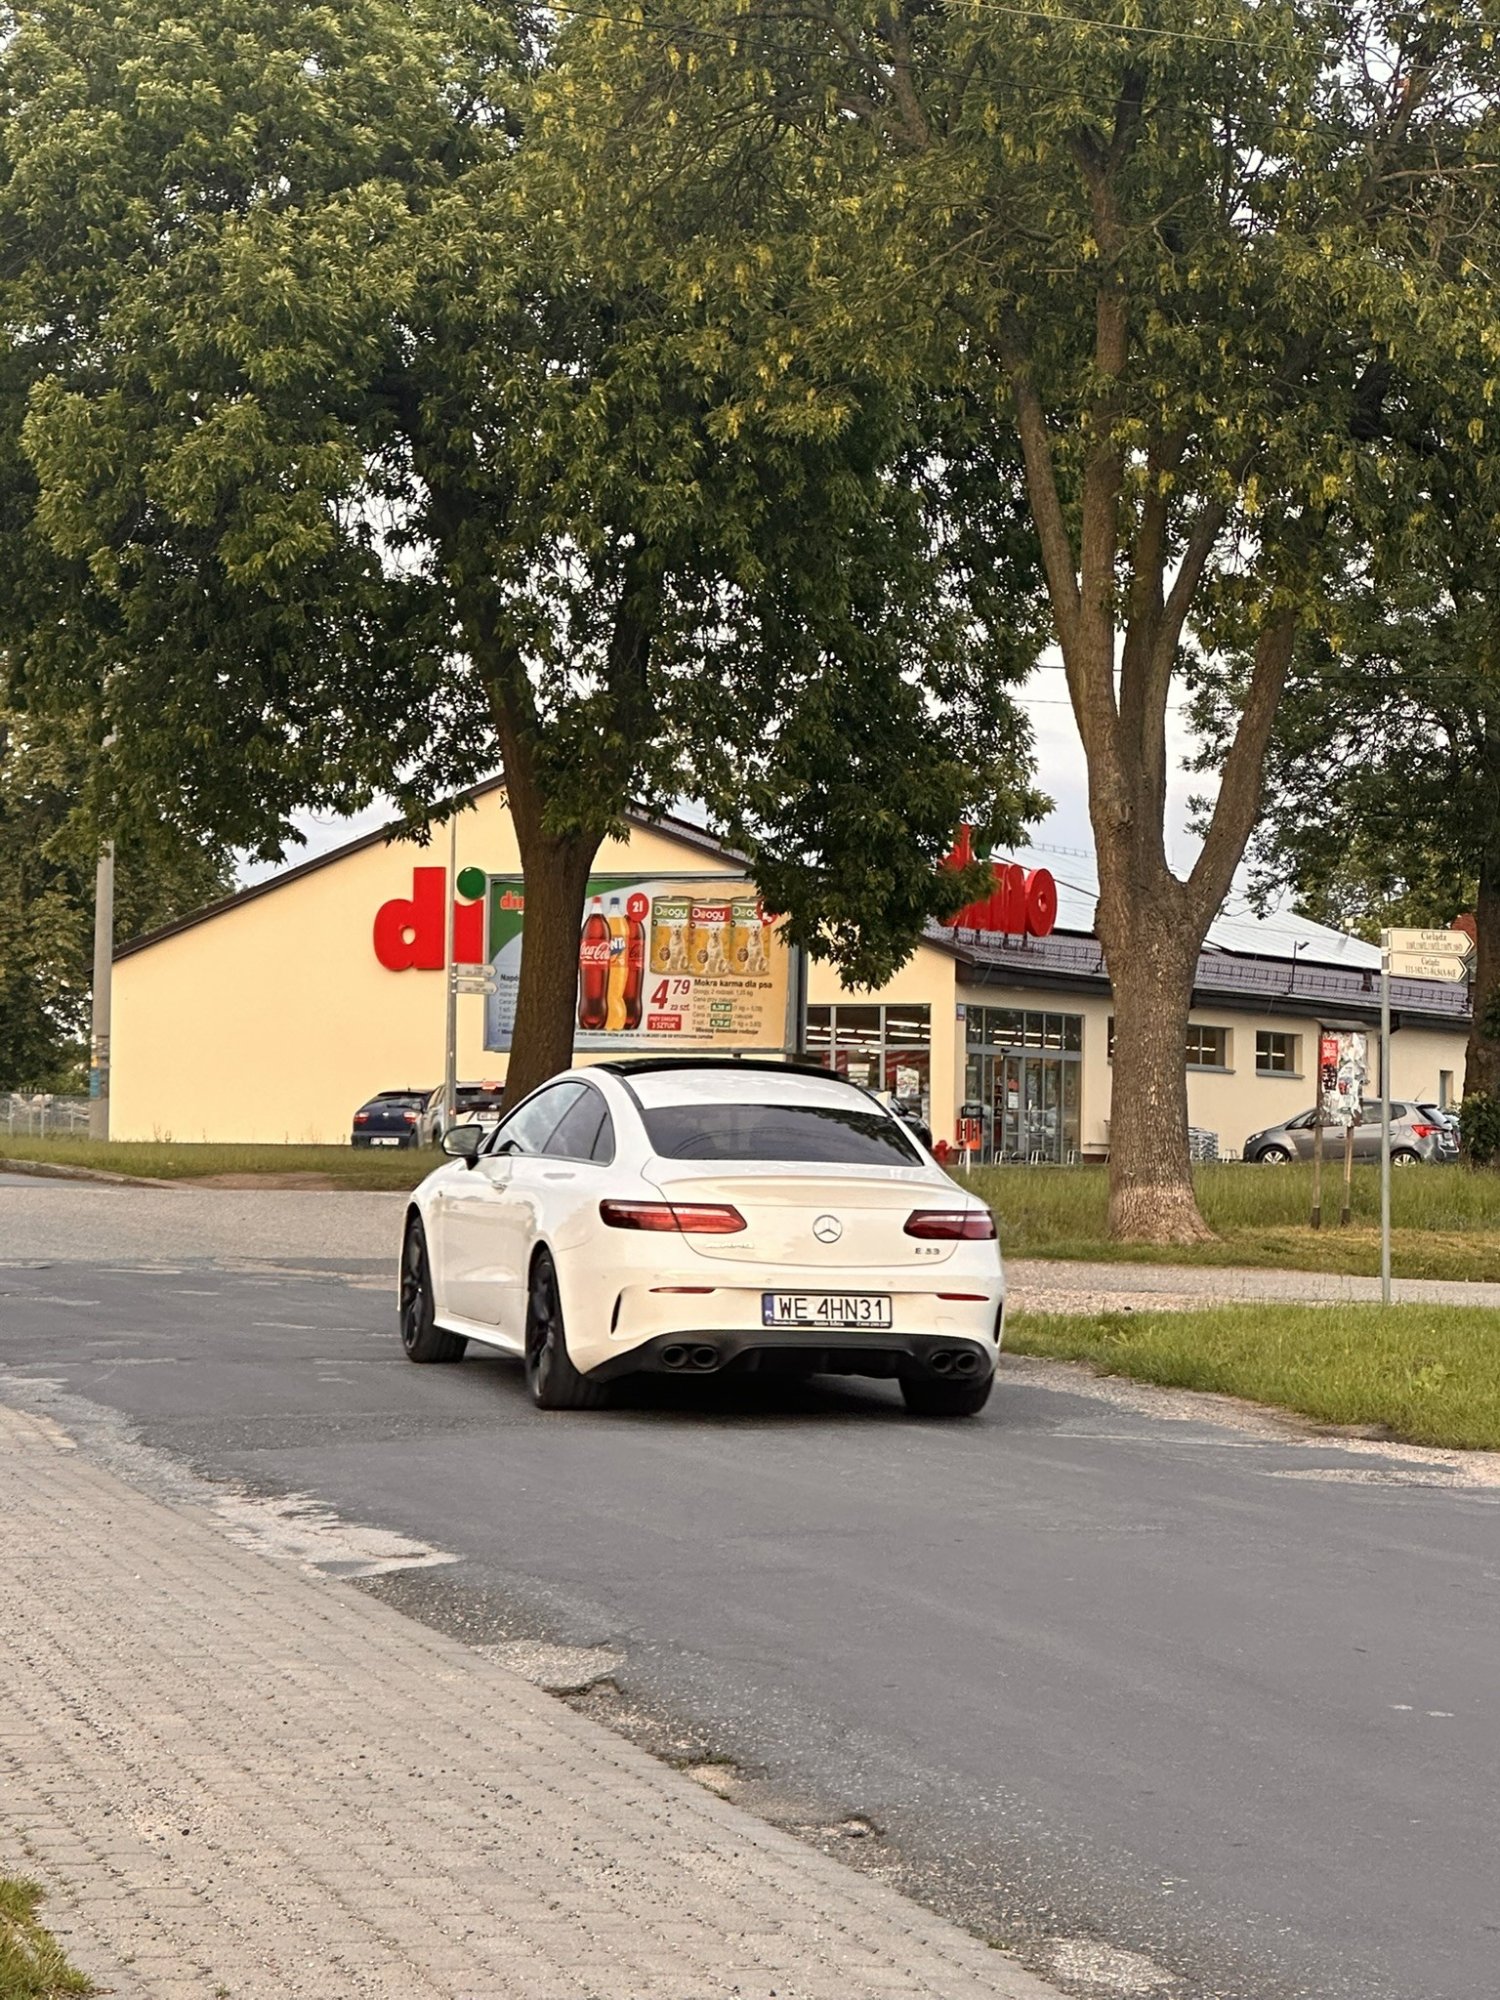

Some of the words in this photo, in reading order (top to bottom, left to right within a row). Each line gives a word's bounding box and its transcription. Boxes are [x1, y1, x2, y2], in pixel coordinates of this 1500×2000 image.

[651, 979, 670, 1010] 4
[672, 980, 691, 995] 79
[693, 979, 718, 987] Mokra
[719, 980, 743, 988] karma
[779, 1297, 807, 1319] WE
[817, 1298, 882, 1320] 4HN31
